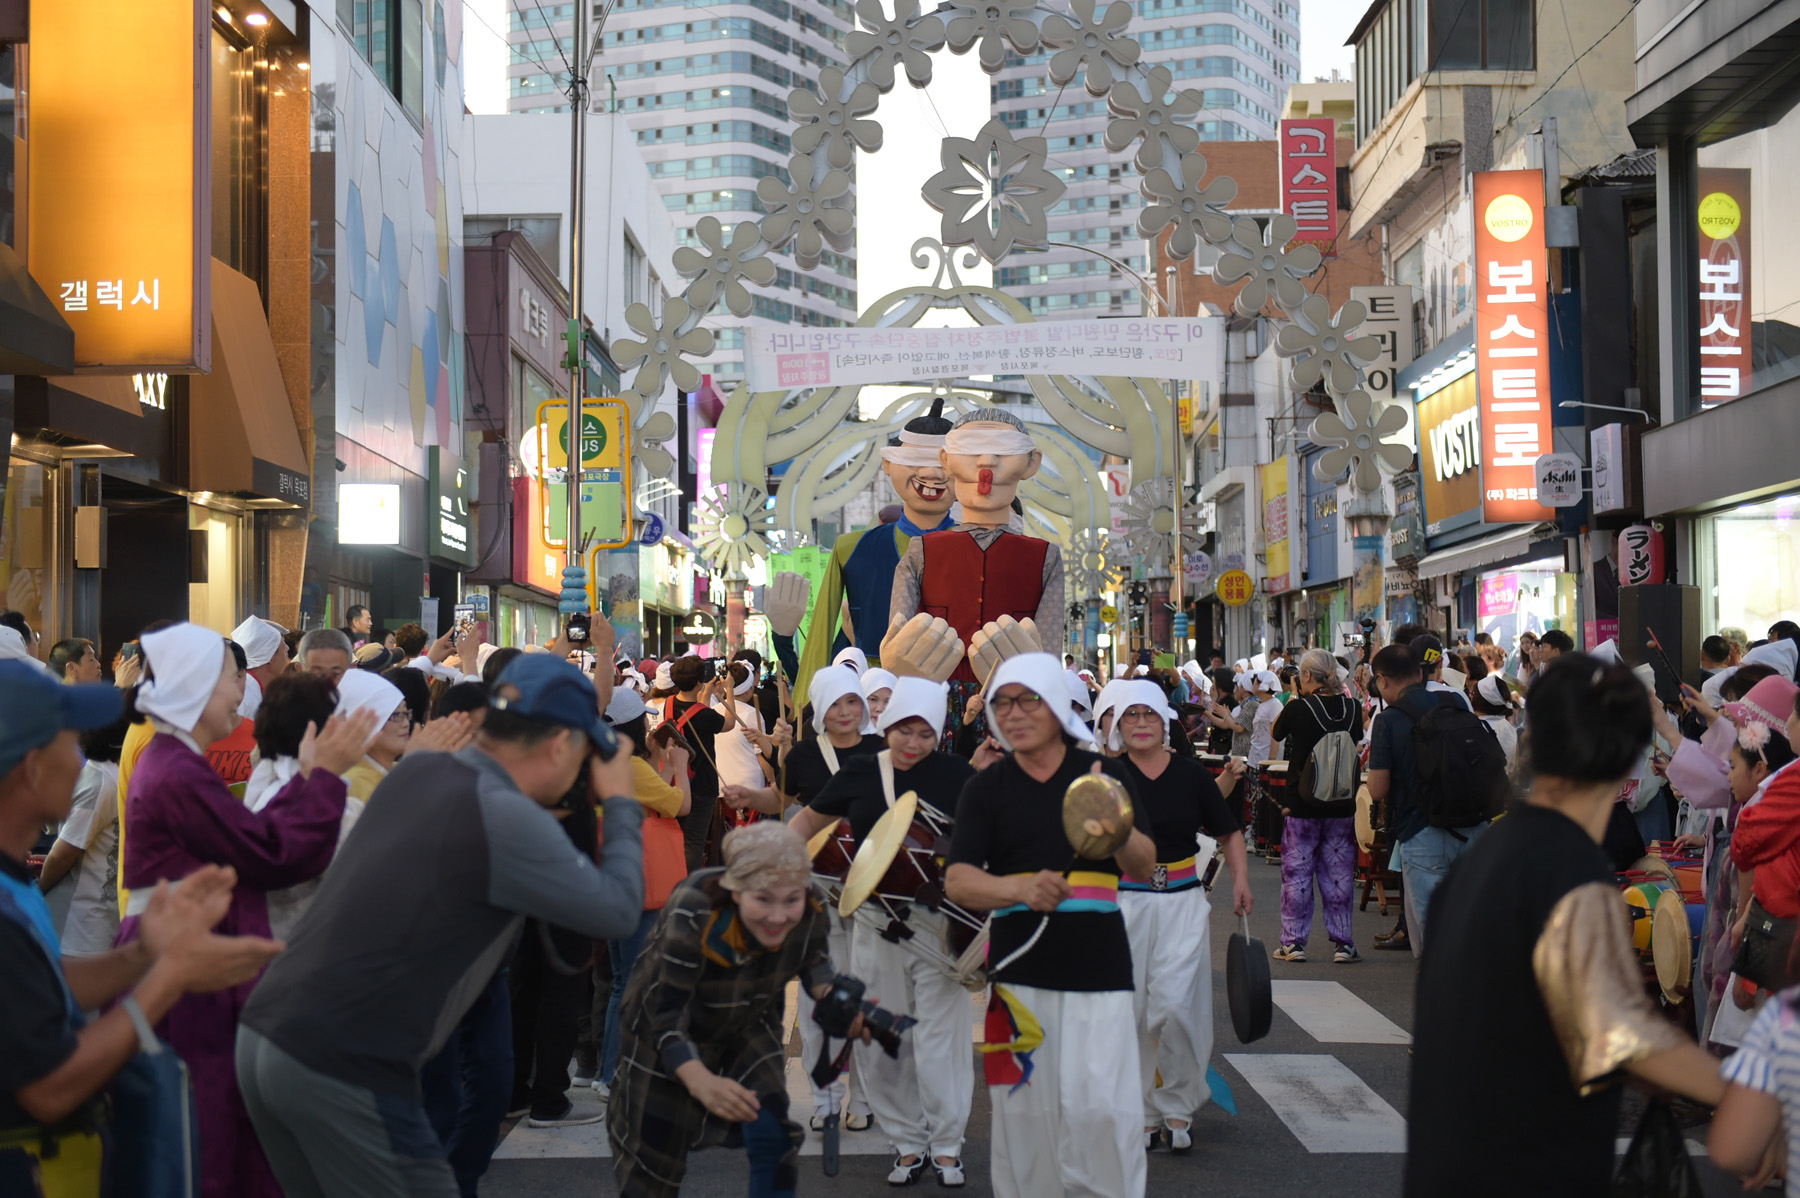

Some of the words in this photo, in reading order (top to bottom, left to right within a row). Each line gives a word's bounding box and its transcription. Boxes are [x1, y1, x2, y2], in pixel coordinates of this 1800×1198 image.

[1288, 127, 1330, 231] 고스트
[1491, 219, 1529, 228] VOSTRO
[60, 278, 160, 312] 갤럭시
[1486, 260, 1542, 467] 보스트로
[583, 421, 598, 435] 스
[582, 439, 600, 453] US
[1542, 469, 1577, 484] Asahi
[1486, 487, 1505, 502] (주)
[1554, 485, 1565, 493] 生
[1625, 528, 1652, 586] ラーメン
[1224, 575, 1245, 588] 성인
[1224, 588, 1245, 601] 용품
[205, 749, 252, 781] IKE
